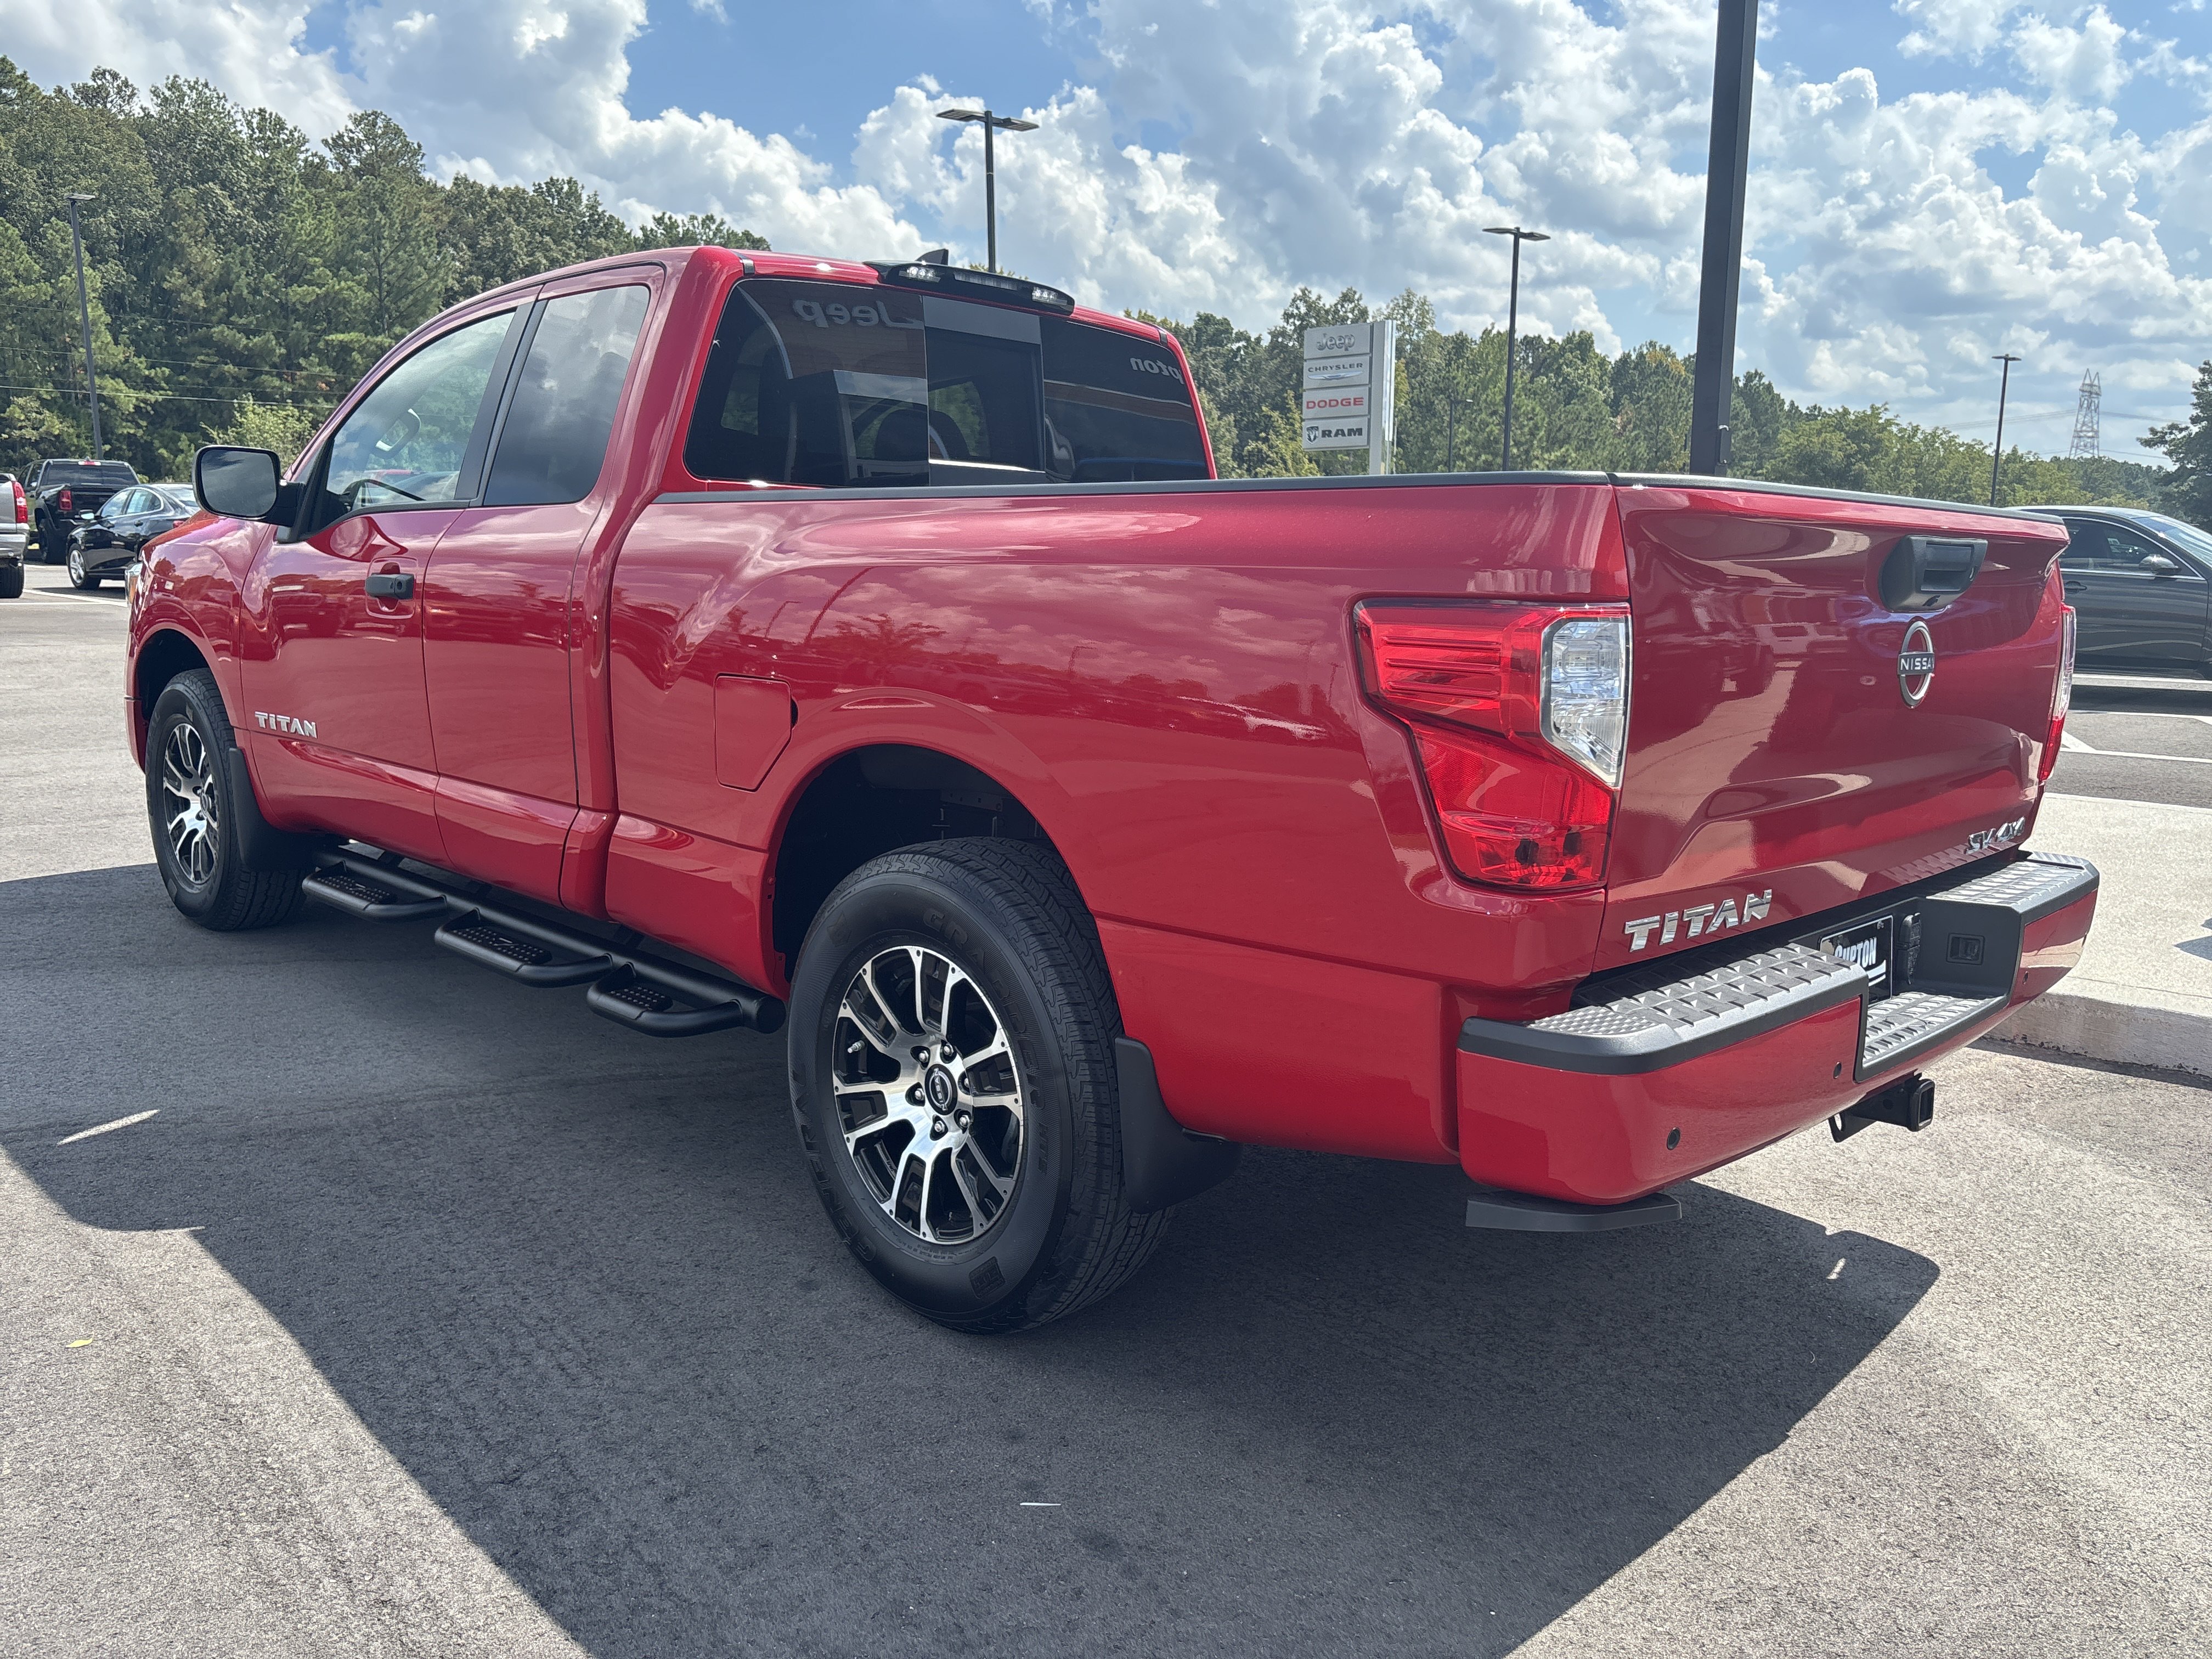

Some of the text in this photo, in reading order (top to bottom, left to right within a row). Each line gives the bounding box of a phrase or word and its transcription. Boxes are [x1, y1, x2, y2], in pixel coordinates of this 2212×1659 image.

[1317, 333, 1356, 351] Jeep
[1308, 363, 1363, 373] CHRYSLER
[1306, 397, 1364, 409] DODGE
[1321, 427, 1363, 438] RAM
[1900, 657, 1935, 670] NISSAN
[255, 711, 318, 739] TITAN
[1624, 888, 1773, 953] TITAN
[934, 1067, 948, 1111] NISSAN
